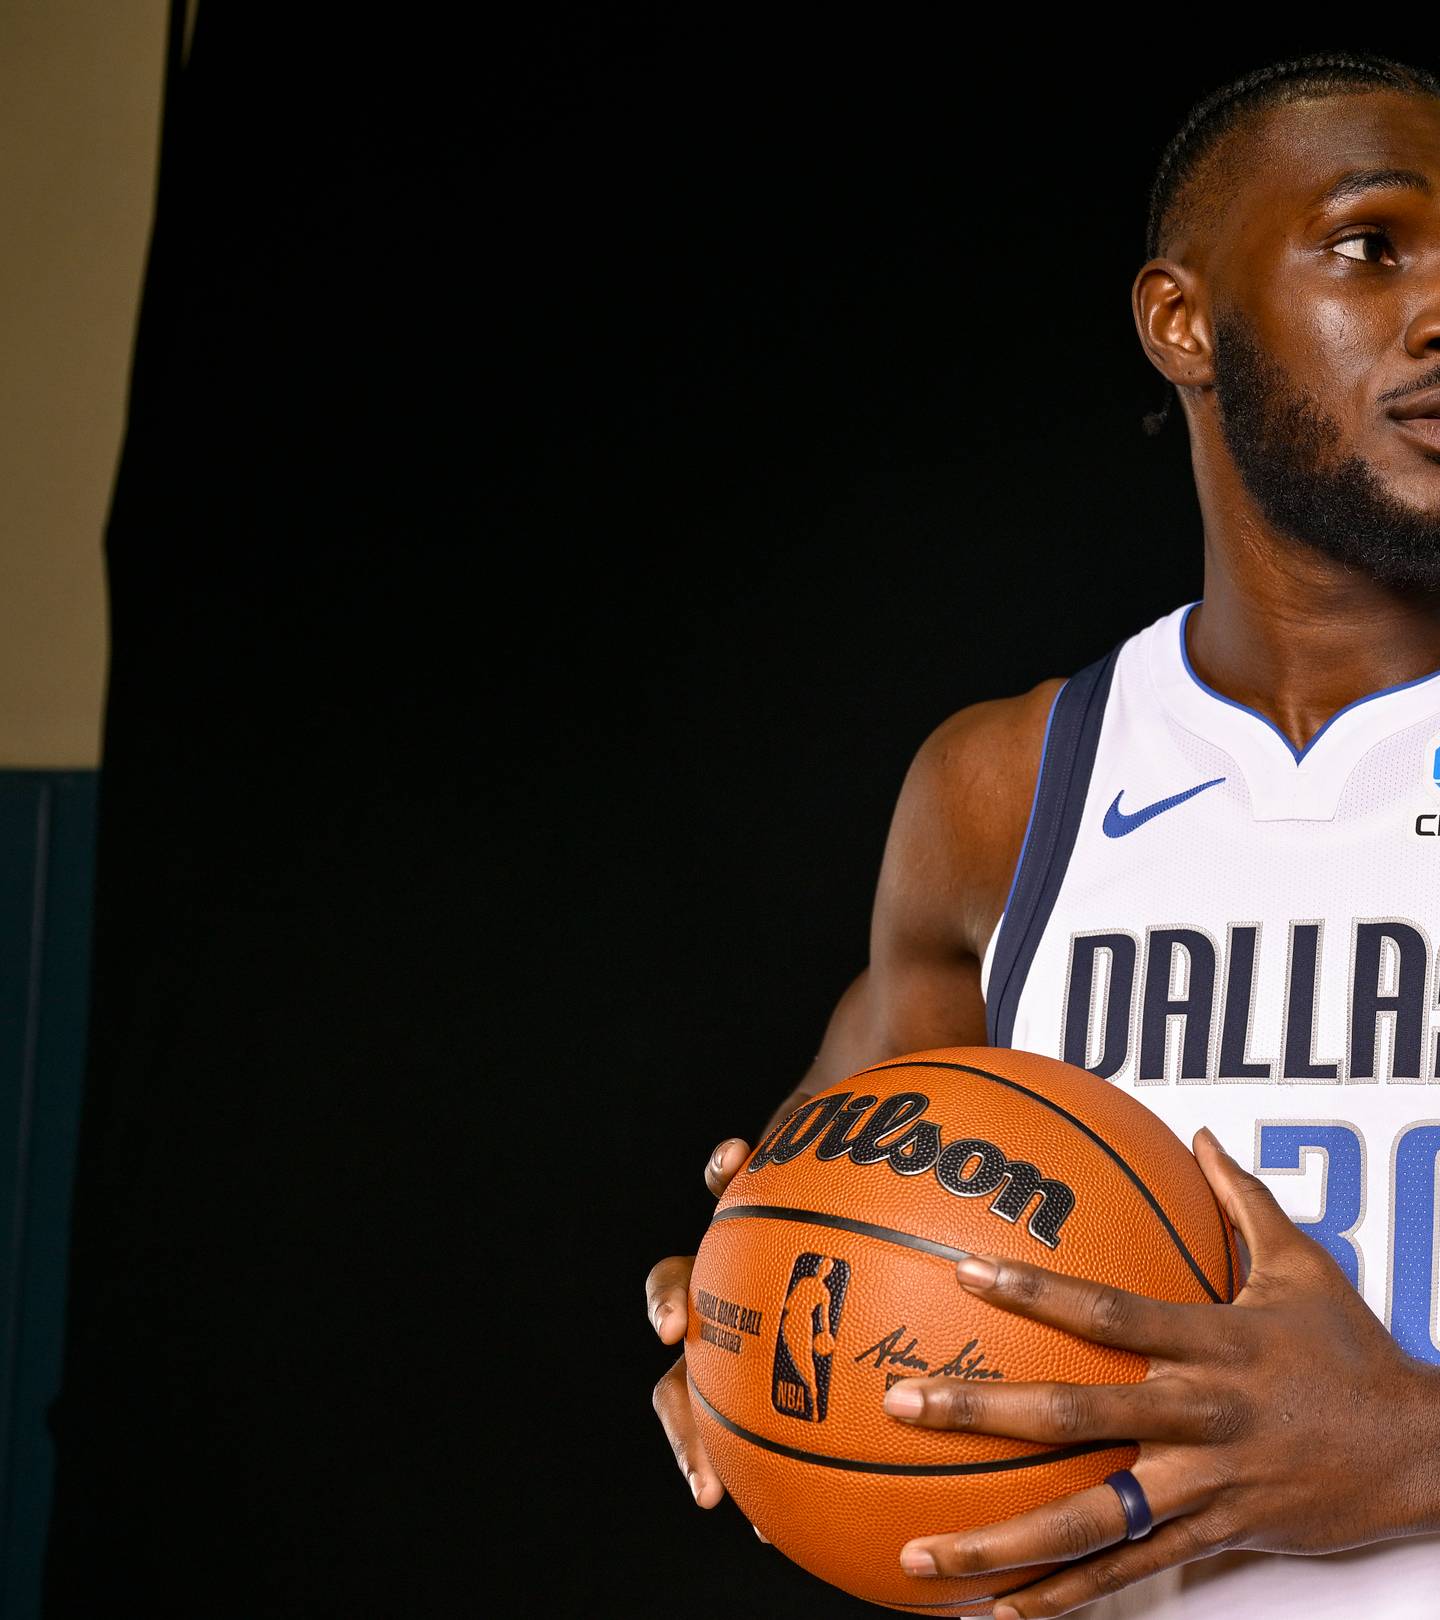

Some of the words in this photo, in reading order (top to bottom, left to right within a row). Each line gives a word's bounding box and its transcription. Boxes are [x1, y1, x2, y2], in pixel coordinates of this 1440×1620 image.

[748, 1091, 1076, 1250] Wilson
[738, 1306, 763, 1337] BALL
[777, 1380, 805, 1412] NBA
